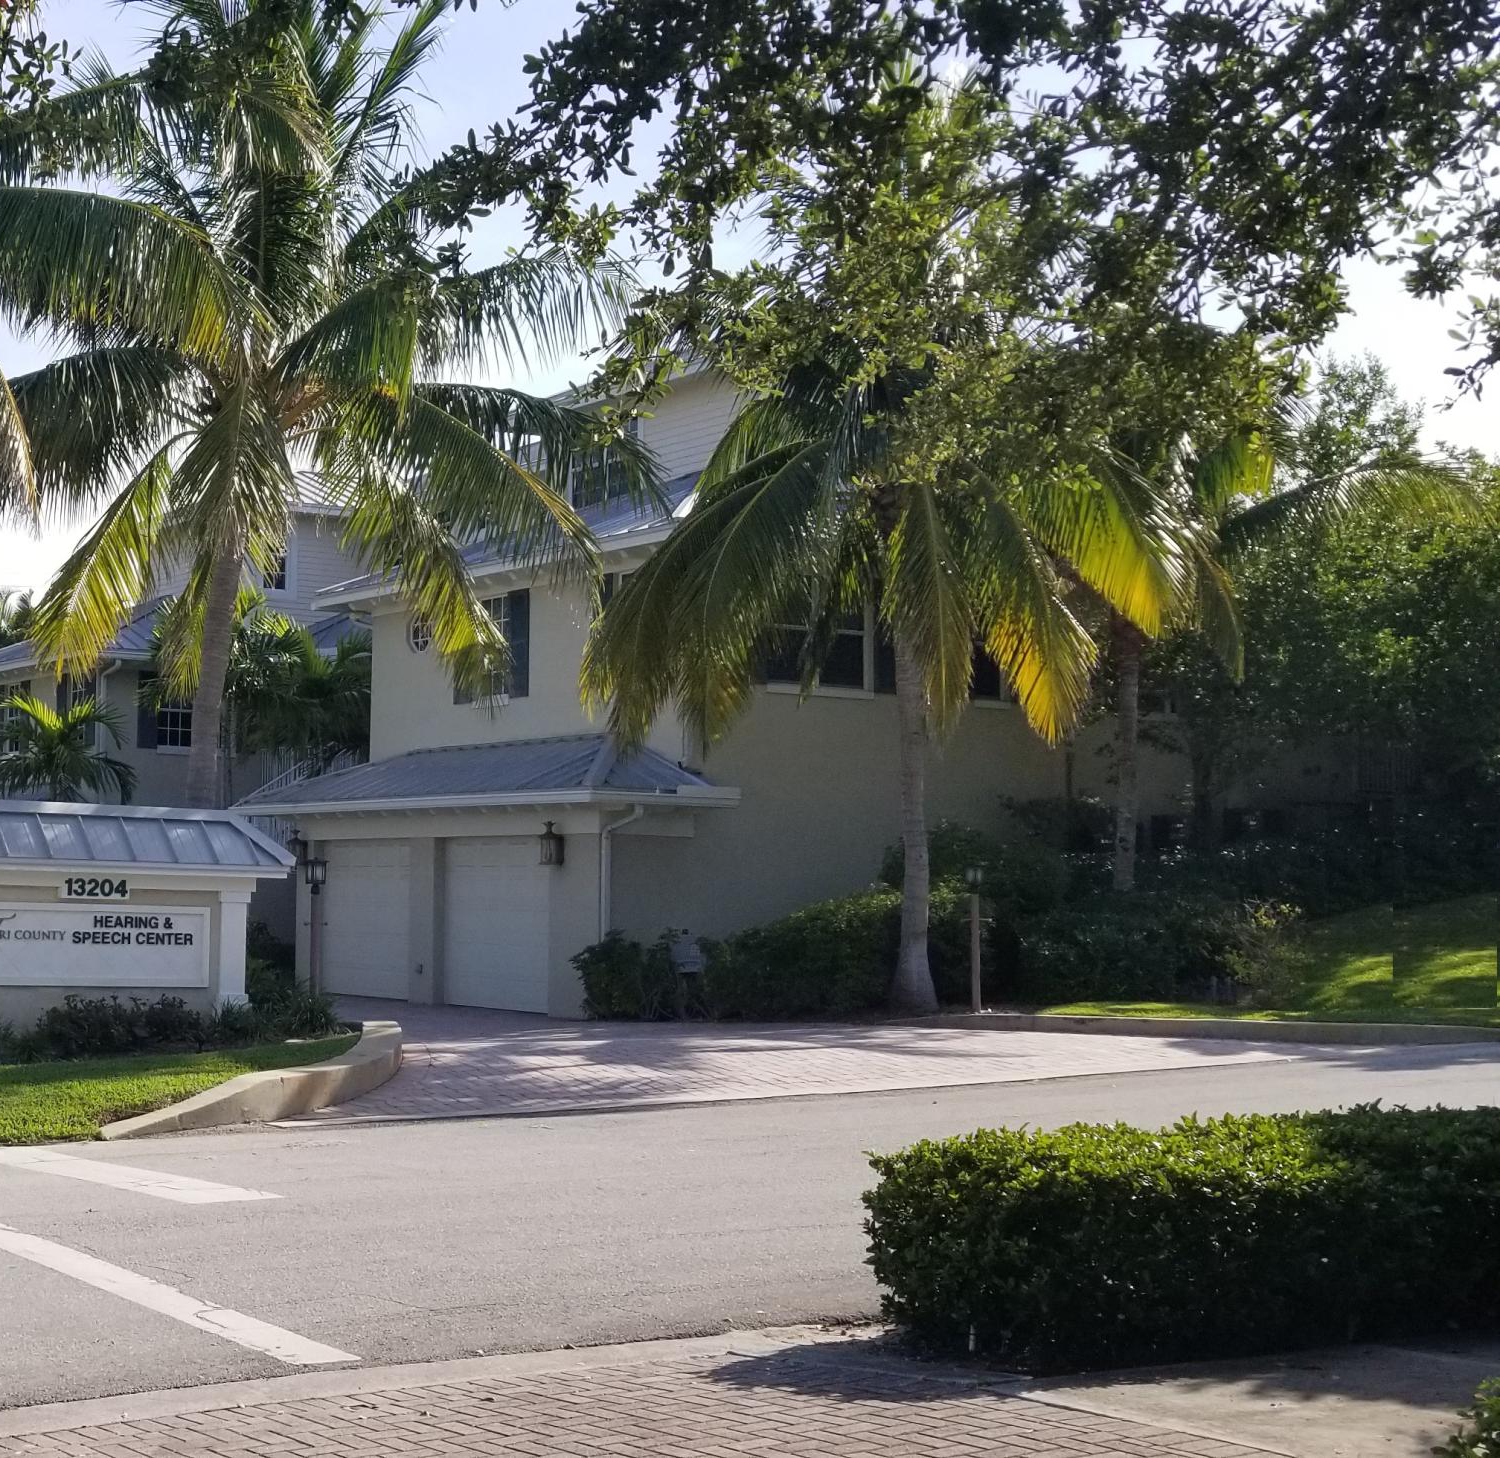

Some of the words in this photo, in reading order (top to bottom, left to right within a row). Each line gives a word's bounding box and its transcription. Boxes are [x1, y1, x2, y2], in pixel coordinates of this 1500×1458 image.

[64, 878, 129, 898] 13204
[93, 915, 159, 929] HEARING
[163, 916, 173, 930] &
[14, 930, 66, 941] COUNTY
[71, 931, 131, 945] SPEECH
[135, 932, 193, 946] CENTER
